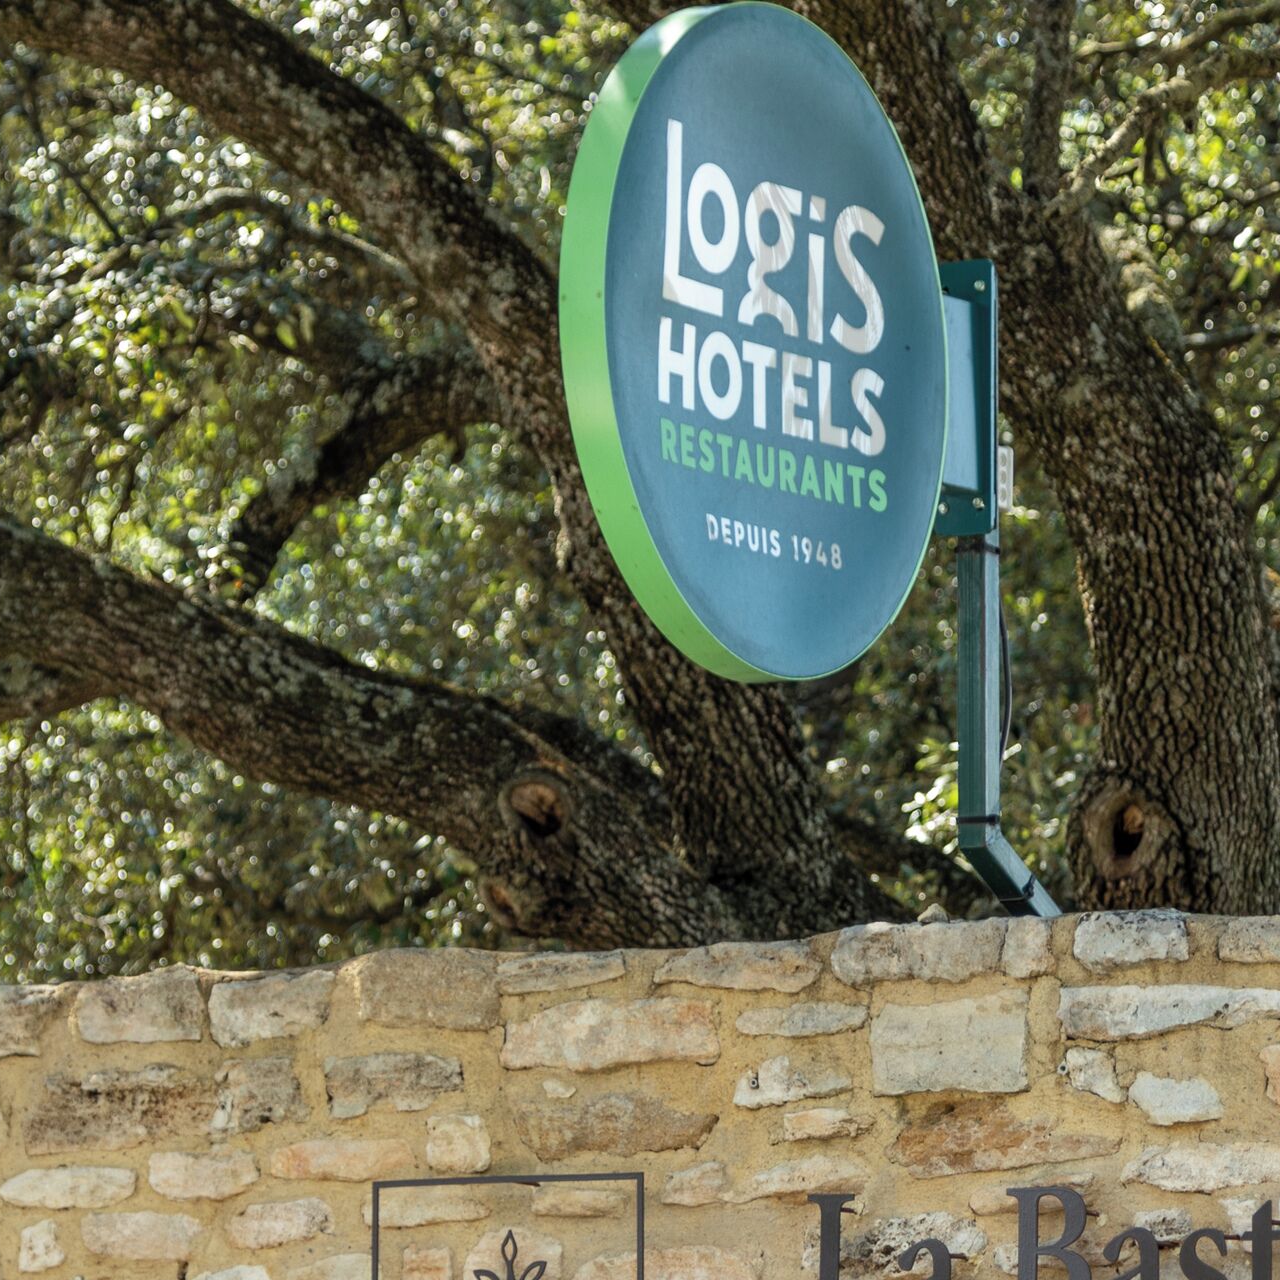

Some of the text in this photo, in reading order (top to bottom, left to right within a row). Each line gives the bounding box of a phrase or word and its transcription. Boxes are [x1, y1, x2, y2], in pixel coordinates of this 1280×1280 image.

[658, 315, 885, 456] HOTELS
[661, 419, 887, 512] RESTAURANTS
[706, 513, 842, 569] DEPUIS 1948
